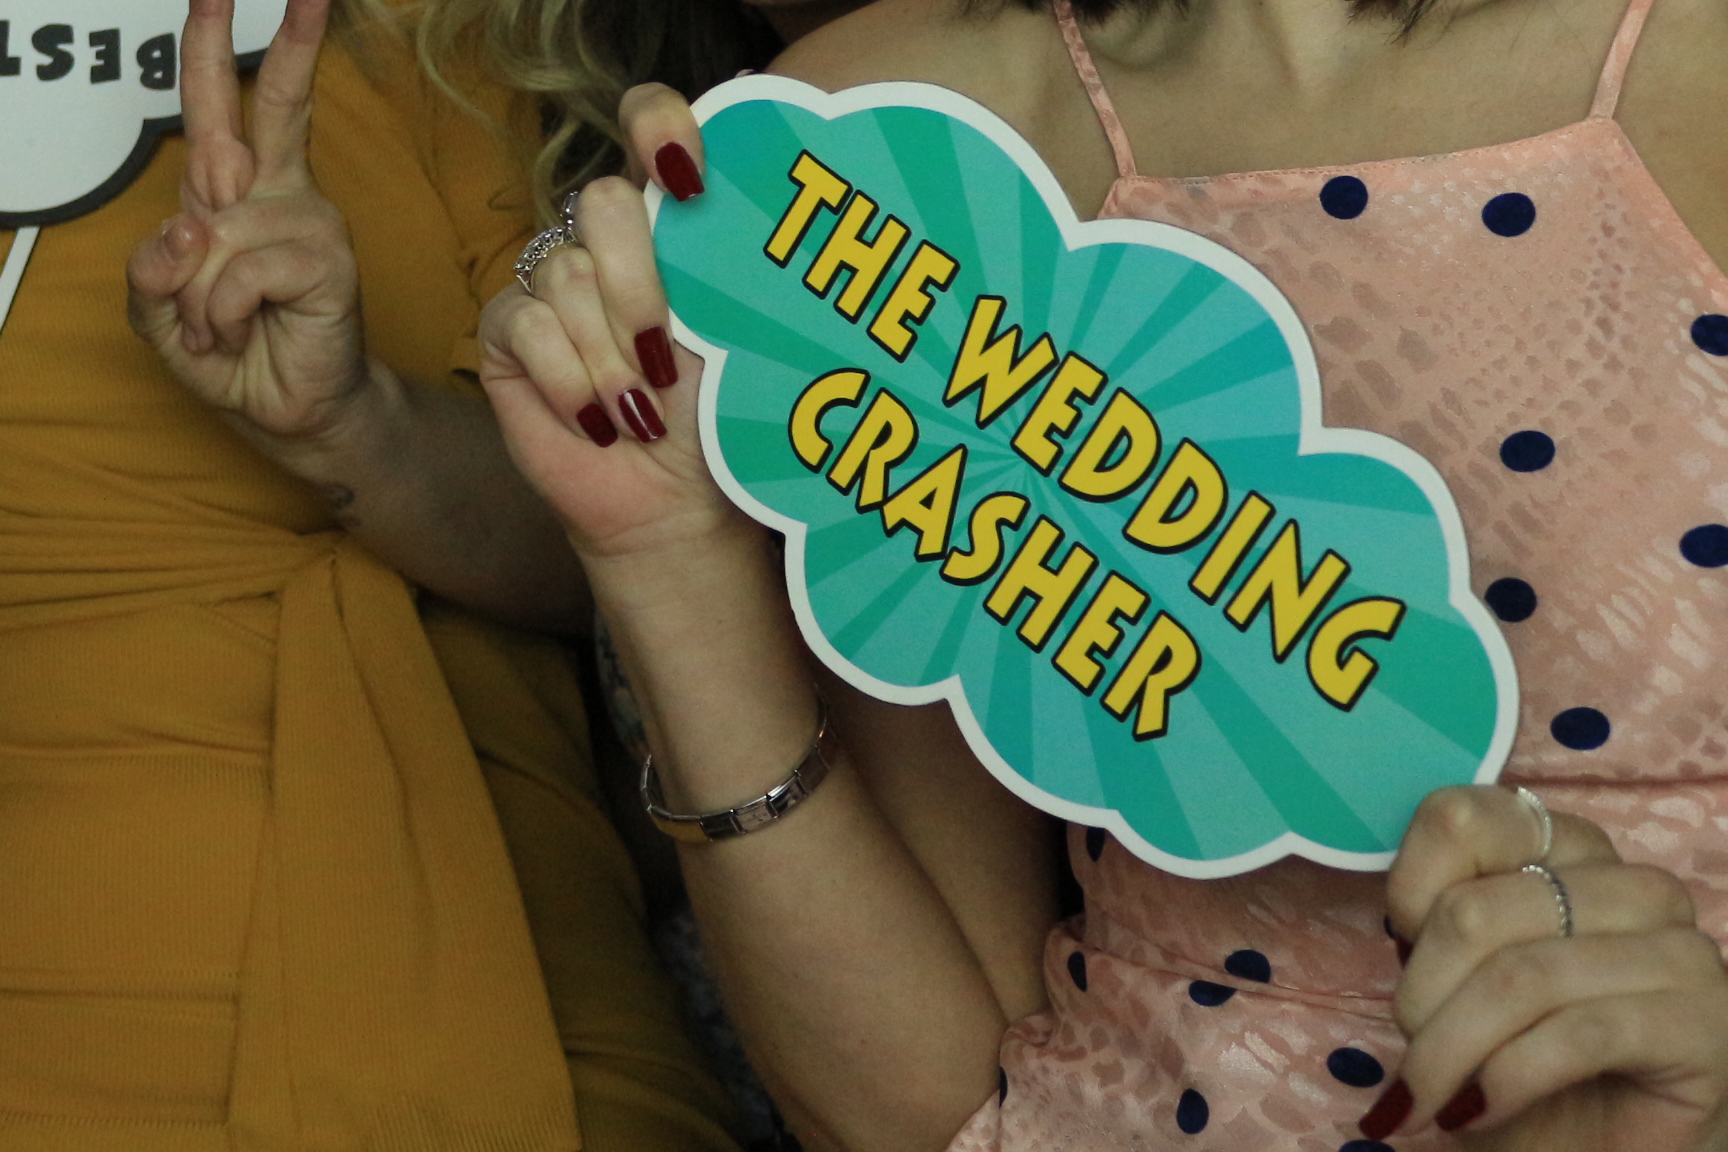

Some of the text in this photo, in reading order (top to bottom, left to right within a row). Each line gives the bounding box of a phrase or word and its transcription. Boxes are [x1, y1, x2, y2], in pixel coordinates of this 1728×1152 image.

[763, 150, 1406, 712] THE WEDDING
[788, 368, 1202, 742] CRASHER
